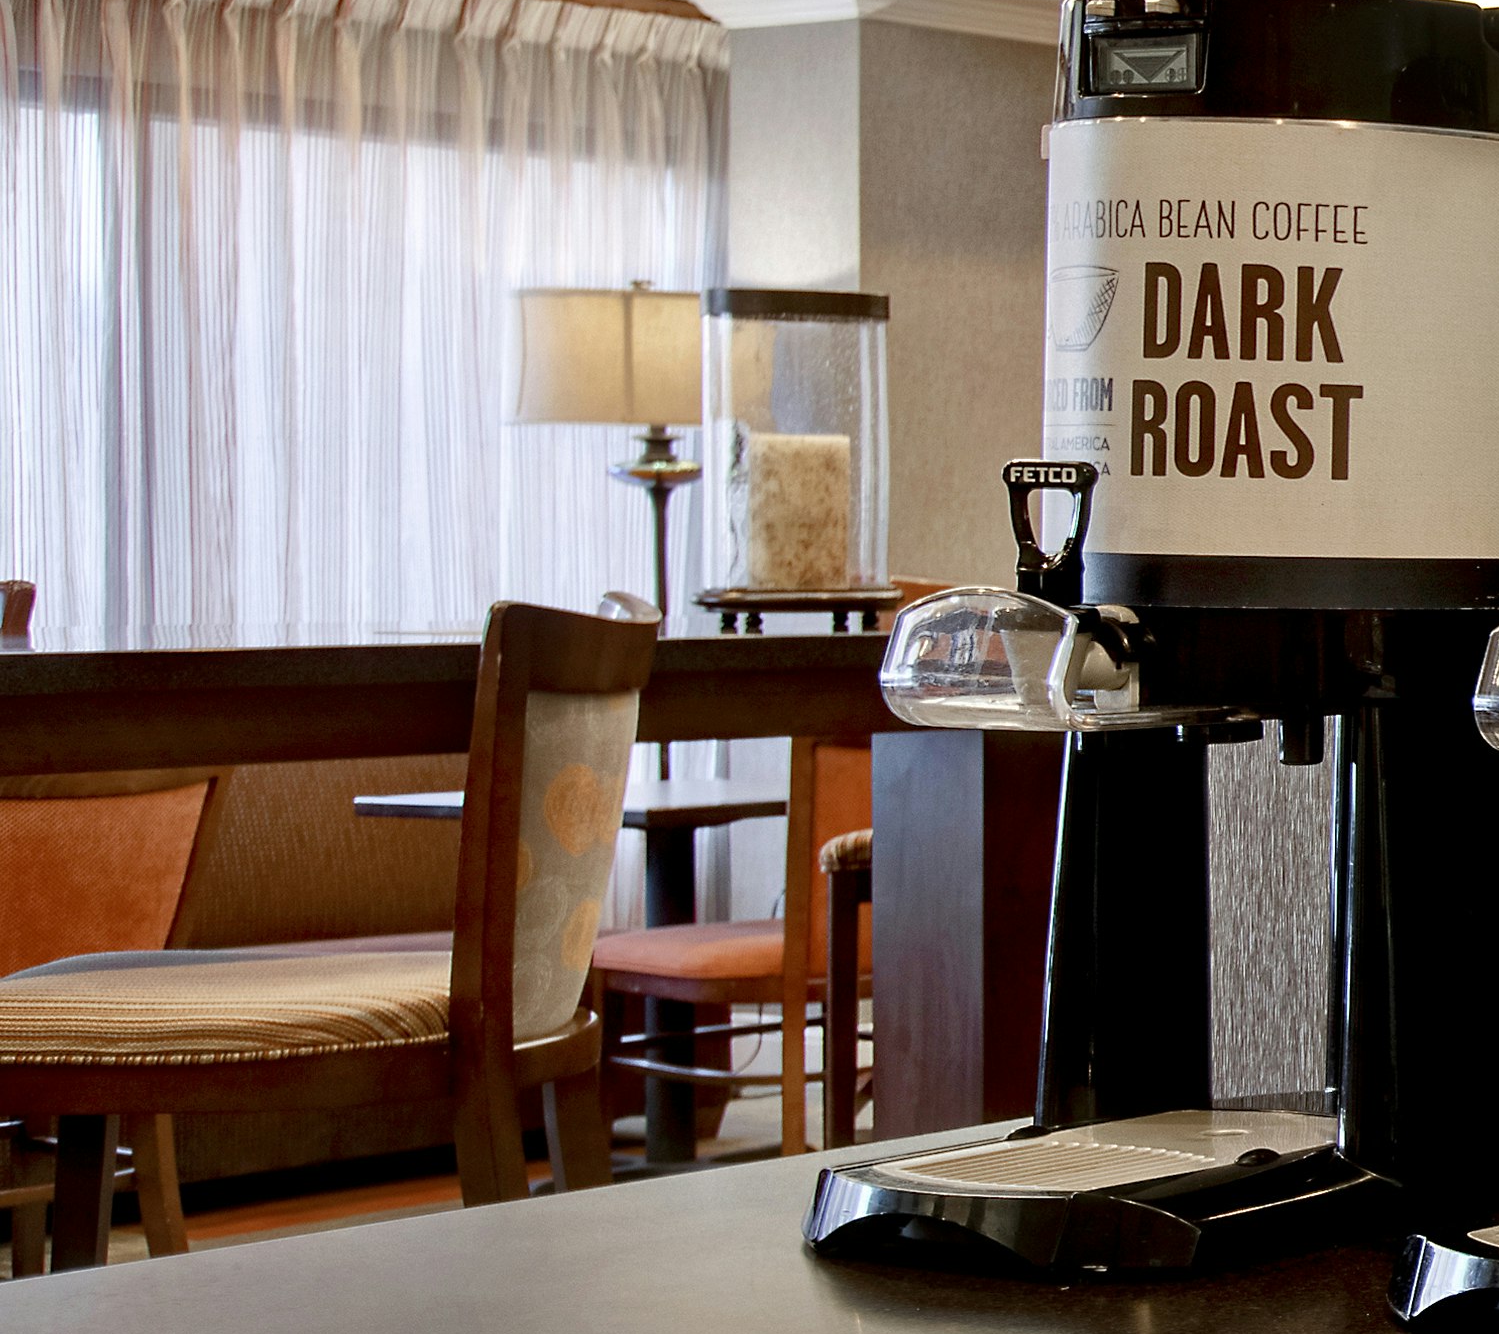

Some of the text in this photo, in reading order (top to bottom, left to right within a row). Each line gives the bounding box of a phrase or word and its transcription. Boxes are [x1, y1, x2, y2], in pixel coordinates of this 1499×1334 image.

[1063, 198, 1146, 241] ARABICA
[1158, 199, 1236, 240] BEAN
[1252, 201, 1369, 245] COFFEE
[1142, 261, 1344, 364] DARK
[1073, 377, 1113, 412] FROM
[1130, 379, 1364, 481] ROAST
[1010, 466, 1077, 483] FETCO
